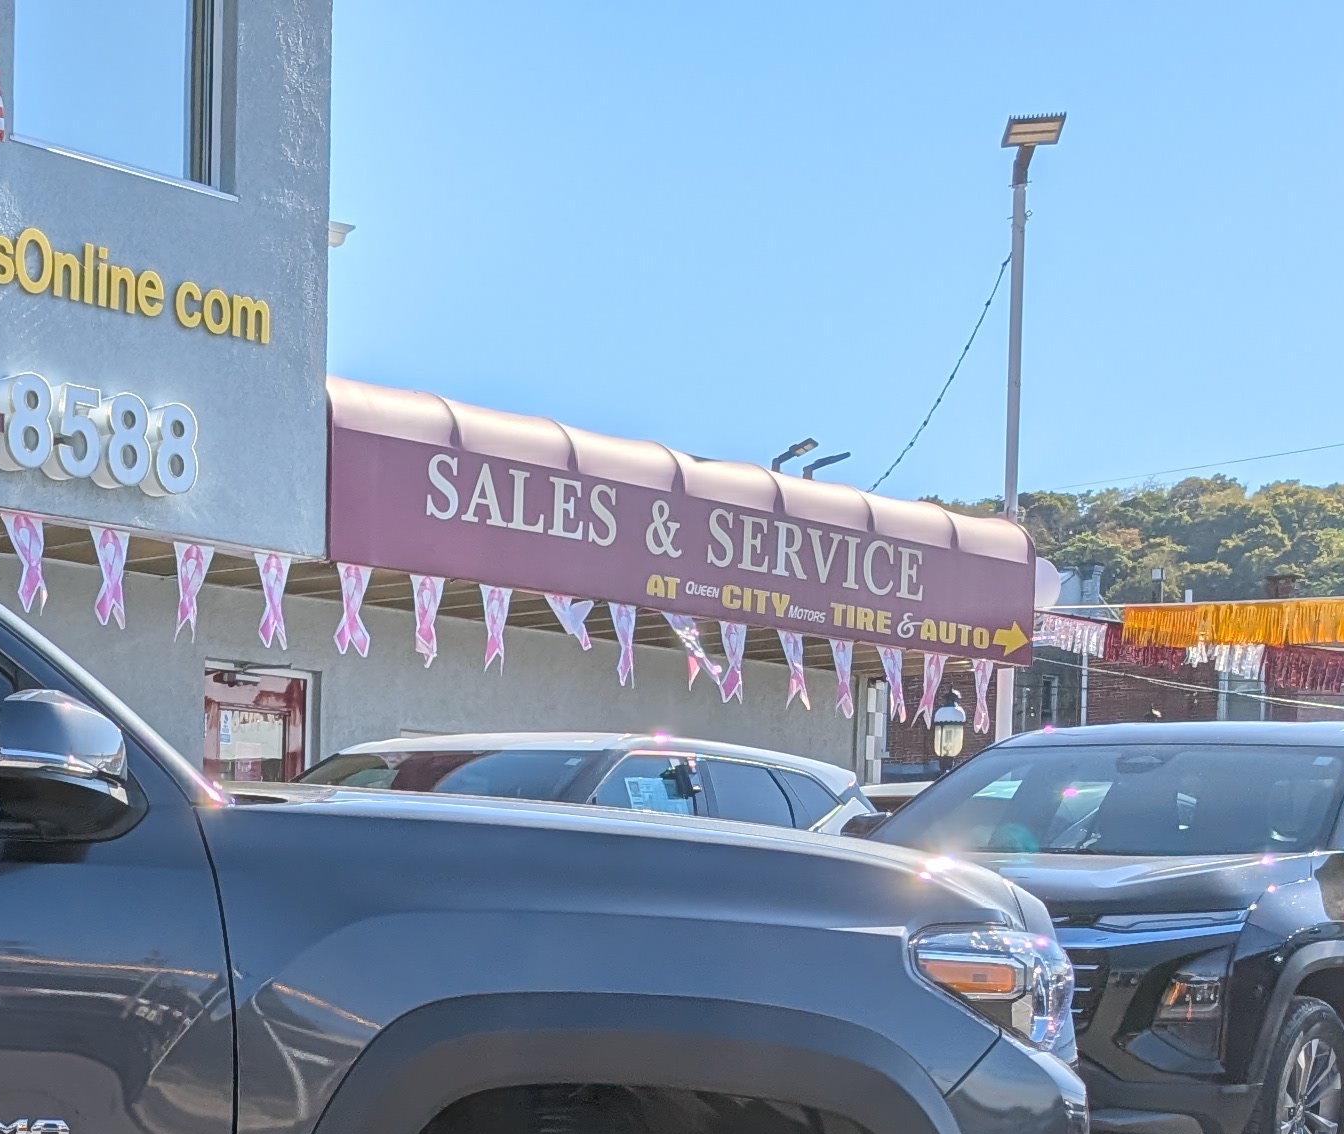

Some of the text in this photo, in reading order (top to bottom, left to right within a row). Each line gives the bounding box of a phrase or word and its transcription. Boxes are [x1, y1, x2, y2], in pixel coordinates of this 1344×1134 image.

[175, 281, 271, 345] com
[425, 453, 925, 602] SALES & SERVICE
[646, 573, 990, 650] AT QUEEN CITY MOTORS TIRE & AUTO
